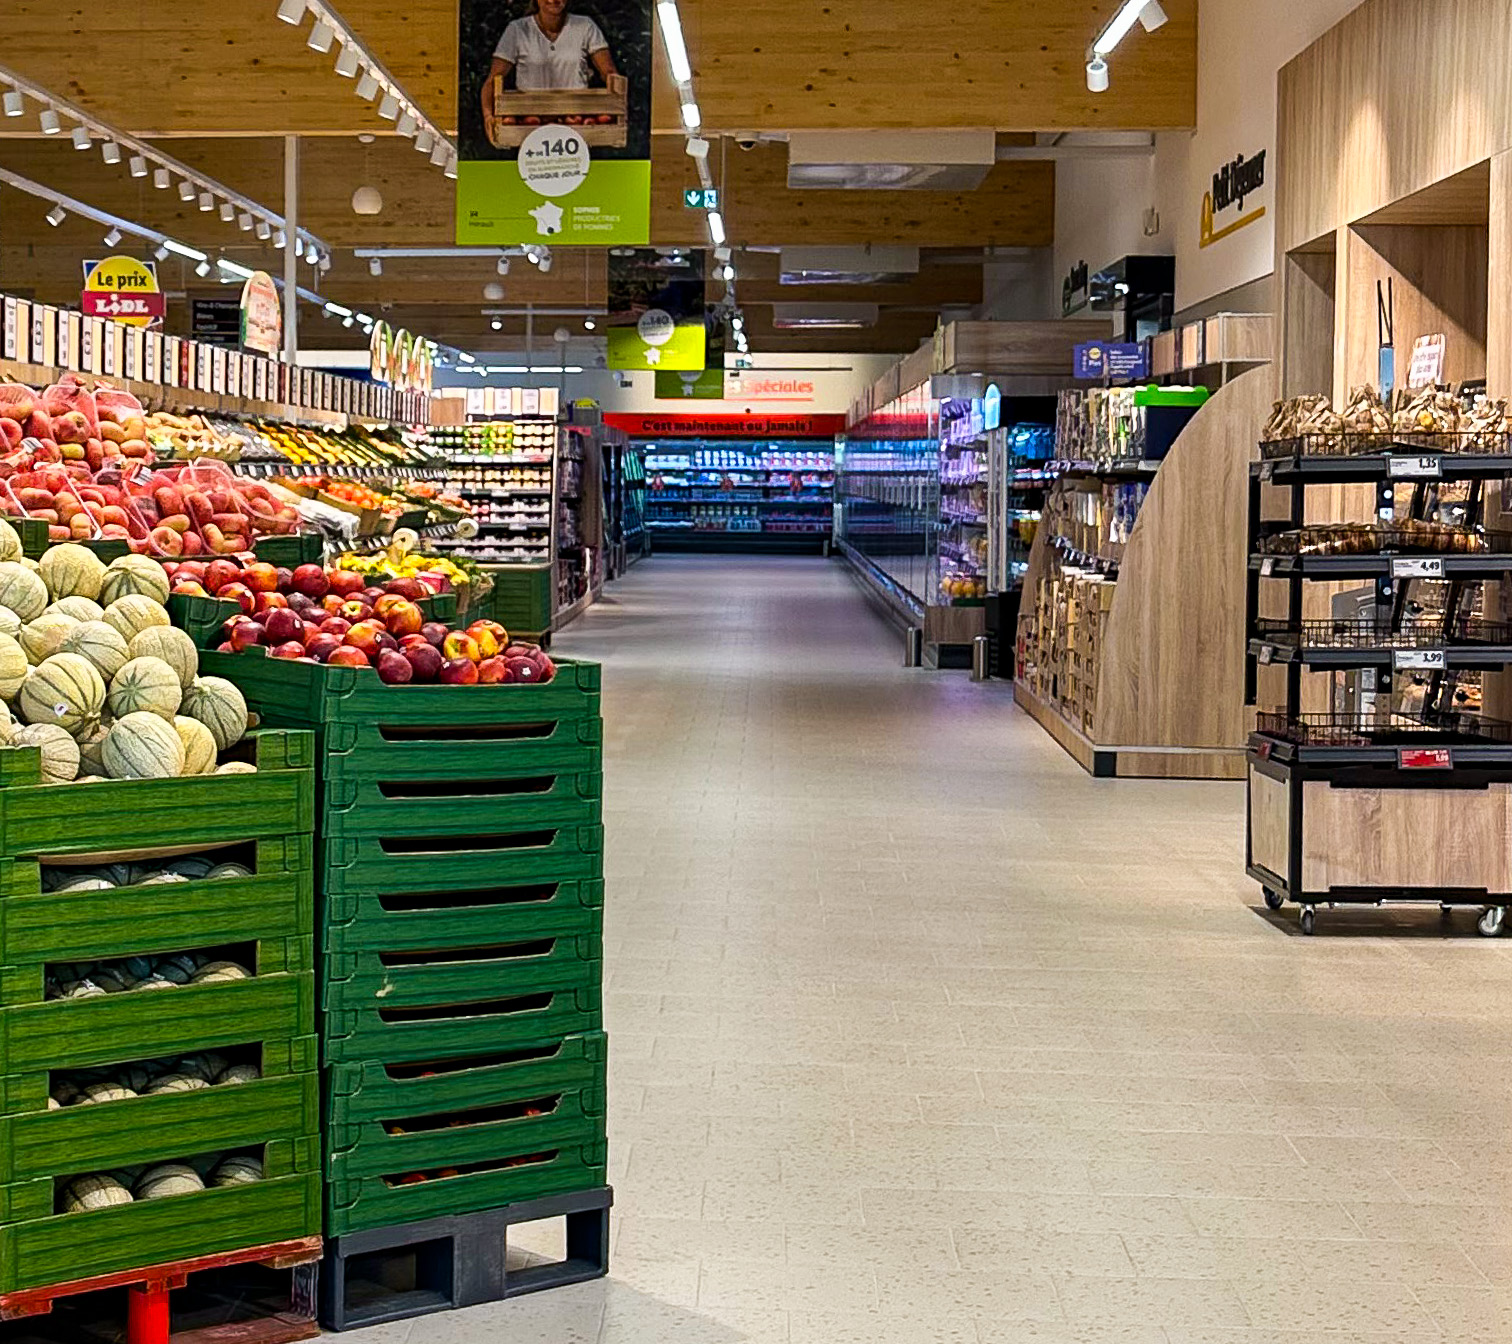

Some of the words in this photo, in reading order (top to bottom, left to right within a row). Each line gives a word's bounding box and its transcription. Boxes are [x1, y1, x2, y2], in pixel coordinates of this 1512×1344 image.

[542, 138, 579, 156] 140
[97, 271, 113, 287] Le
[117, 270, 148, 289] prix
[641, 419, 672, 432] C'est
[674, 419, 744, 432] maintenant
[765, 419, 807, 434] jamais
[1420, 561, 1440, 572] 4,49
